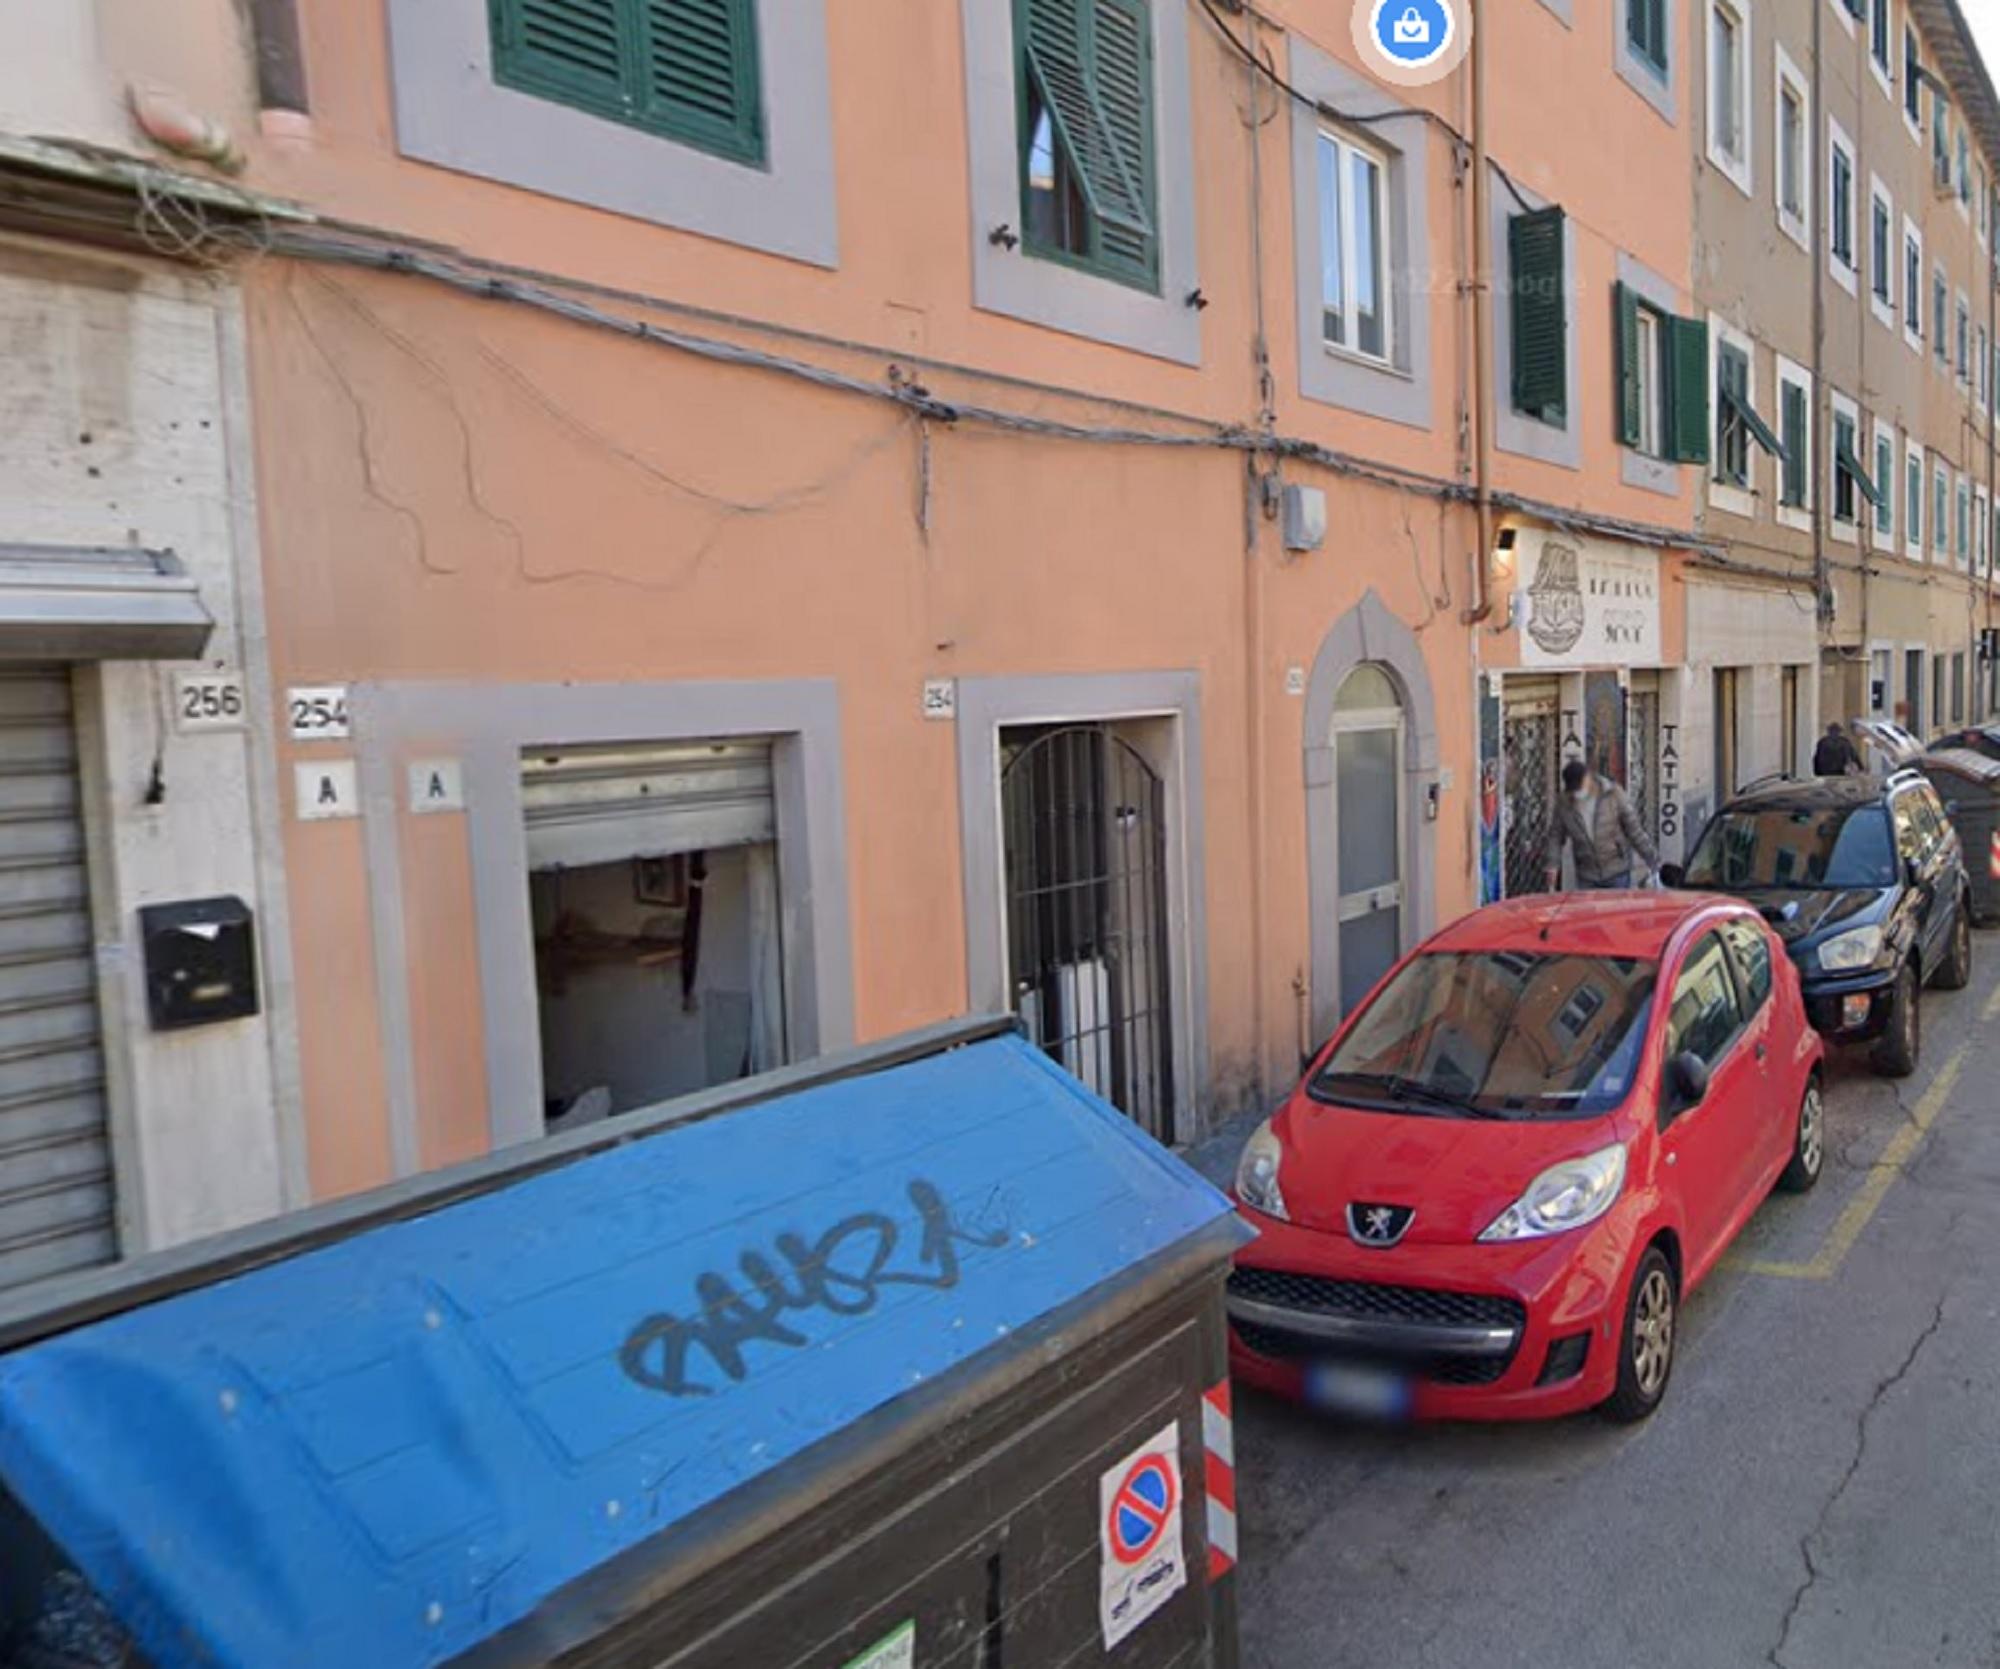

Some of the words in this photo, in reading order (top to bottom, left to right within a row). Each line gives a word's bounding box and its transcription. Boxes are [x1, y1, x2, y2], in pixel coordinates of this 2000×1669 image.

[183, 685, 242, 718] 256
[292, 699, 348, 729] 254
[1562, 709, 1582, 759] TA
[318, 776, 338, 804] A
[429, 770, 446, 798] A
[1661, 724, 1679, 837] TATTOO
